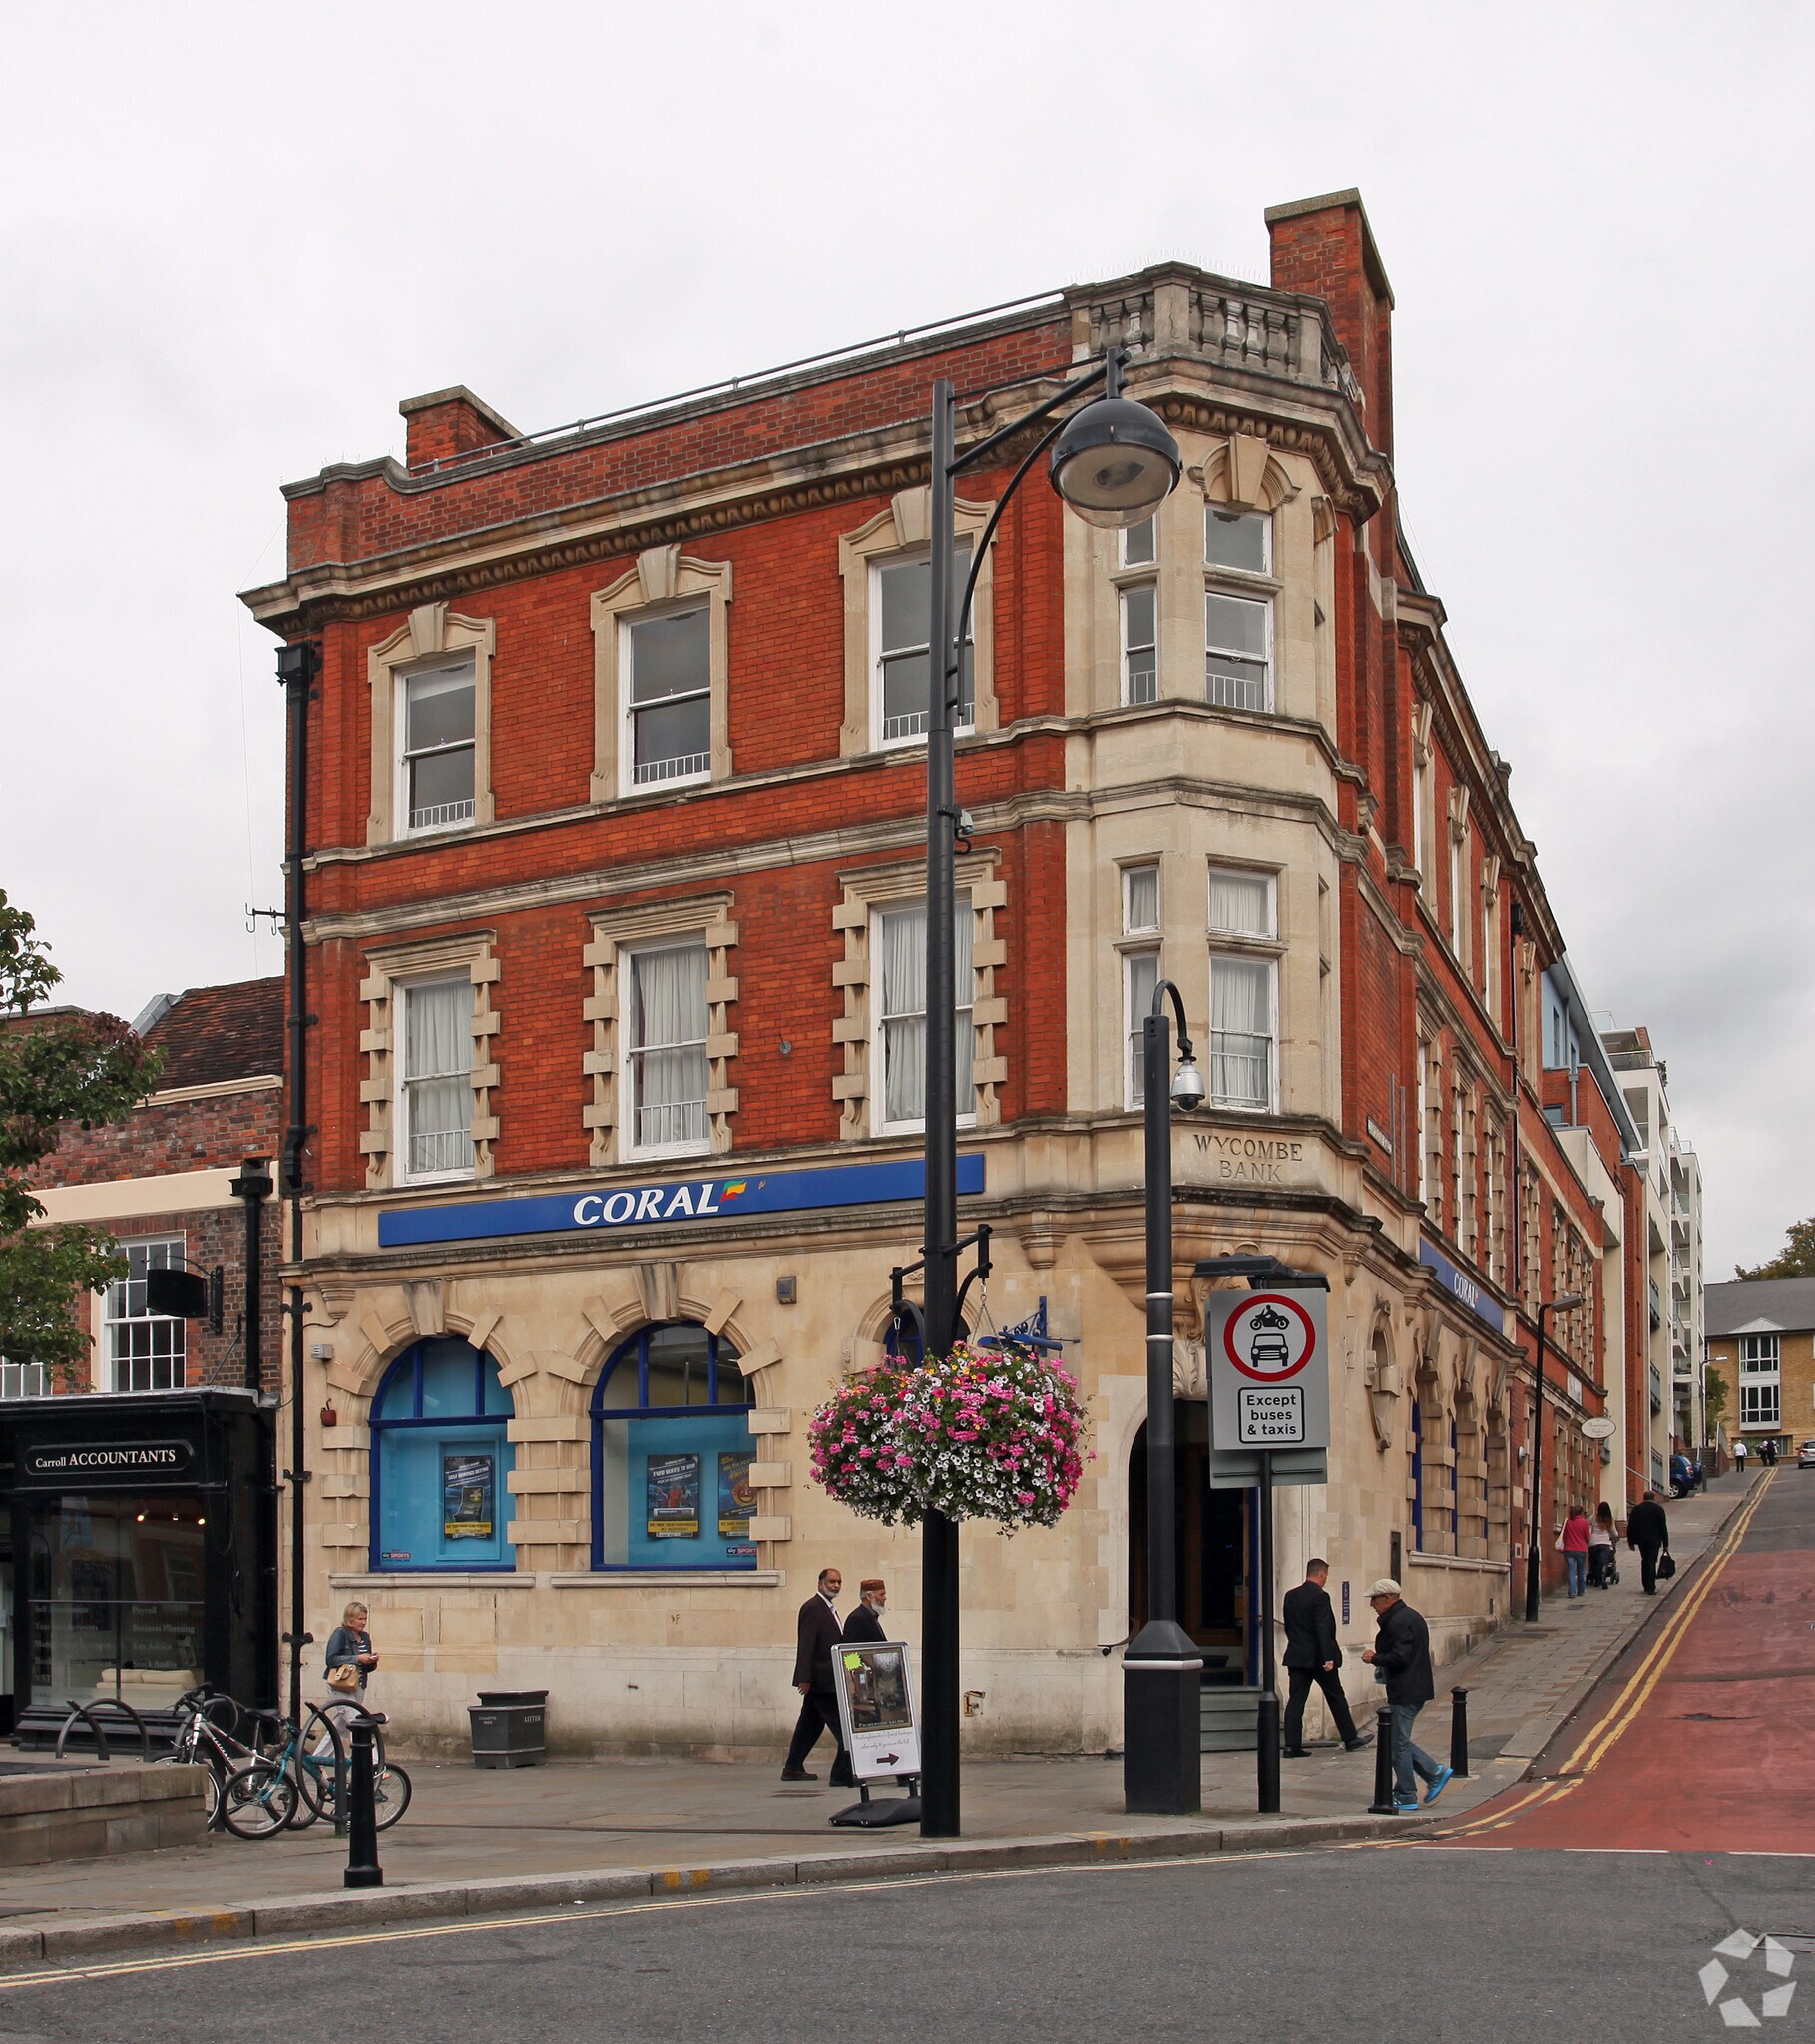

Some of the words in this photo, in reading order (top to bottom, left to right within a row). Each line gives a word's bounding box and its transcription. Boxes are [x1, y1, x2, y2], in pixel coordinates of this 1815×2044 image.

[1193, 1134, 1303, 1162] WYCOMBE
[1219, 1159, 1283, 1183] BANK
[573, 1183, 720, 1225] CORAL
[1454, 1272, 1475, 1308] CORAL
[1246, 1394, 1297, 1407] Except
[1250, 1409, 1293, 1421] buses
[1247, 1424, 1257, 1435] &
[1261, 1423, 1297, 1435] taxis
[35, 1456, 67, 1469] Carroll
[68, 1449, 176, 1467] ACCOUNTANTS
